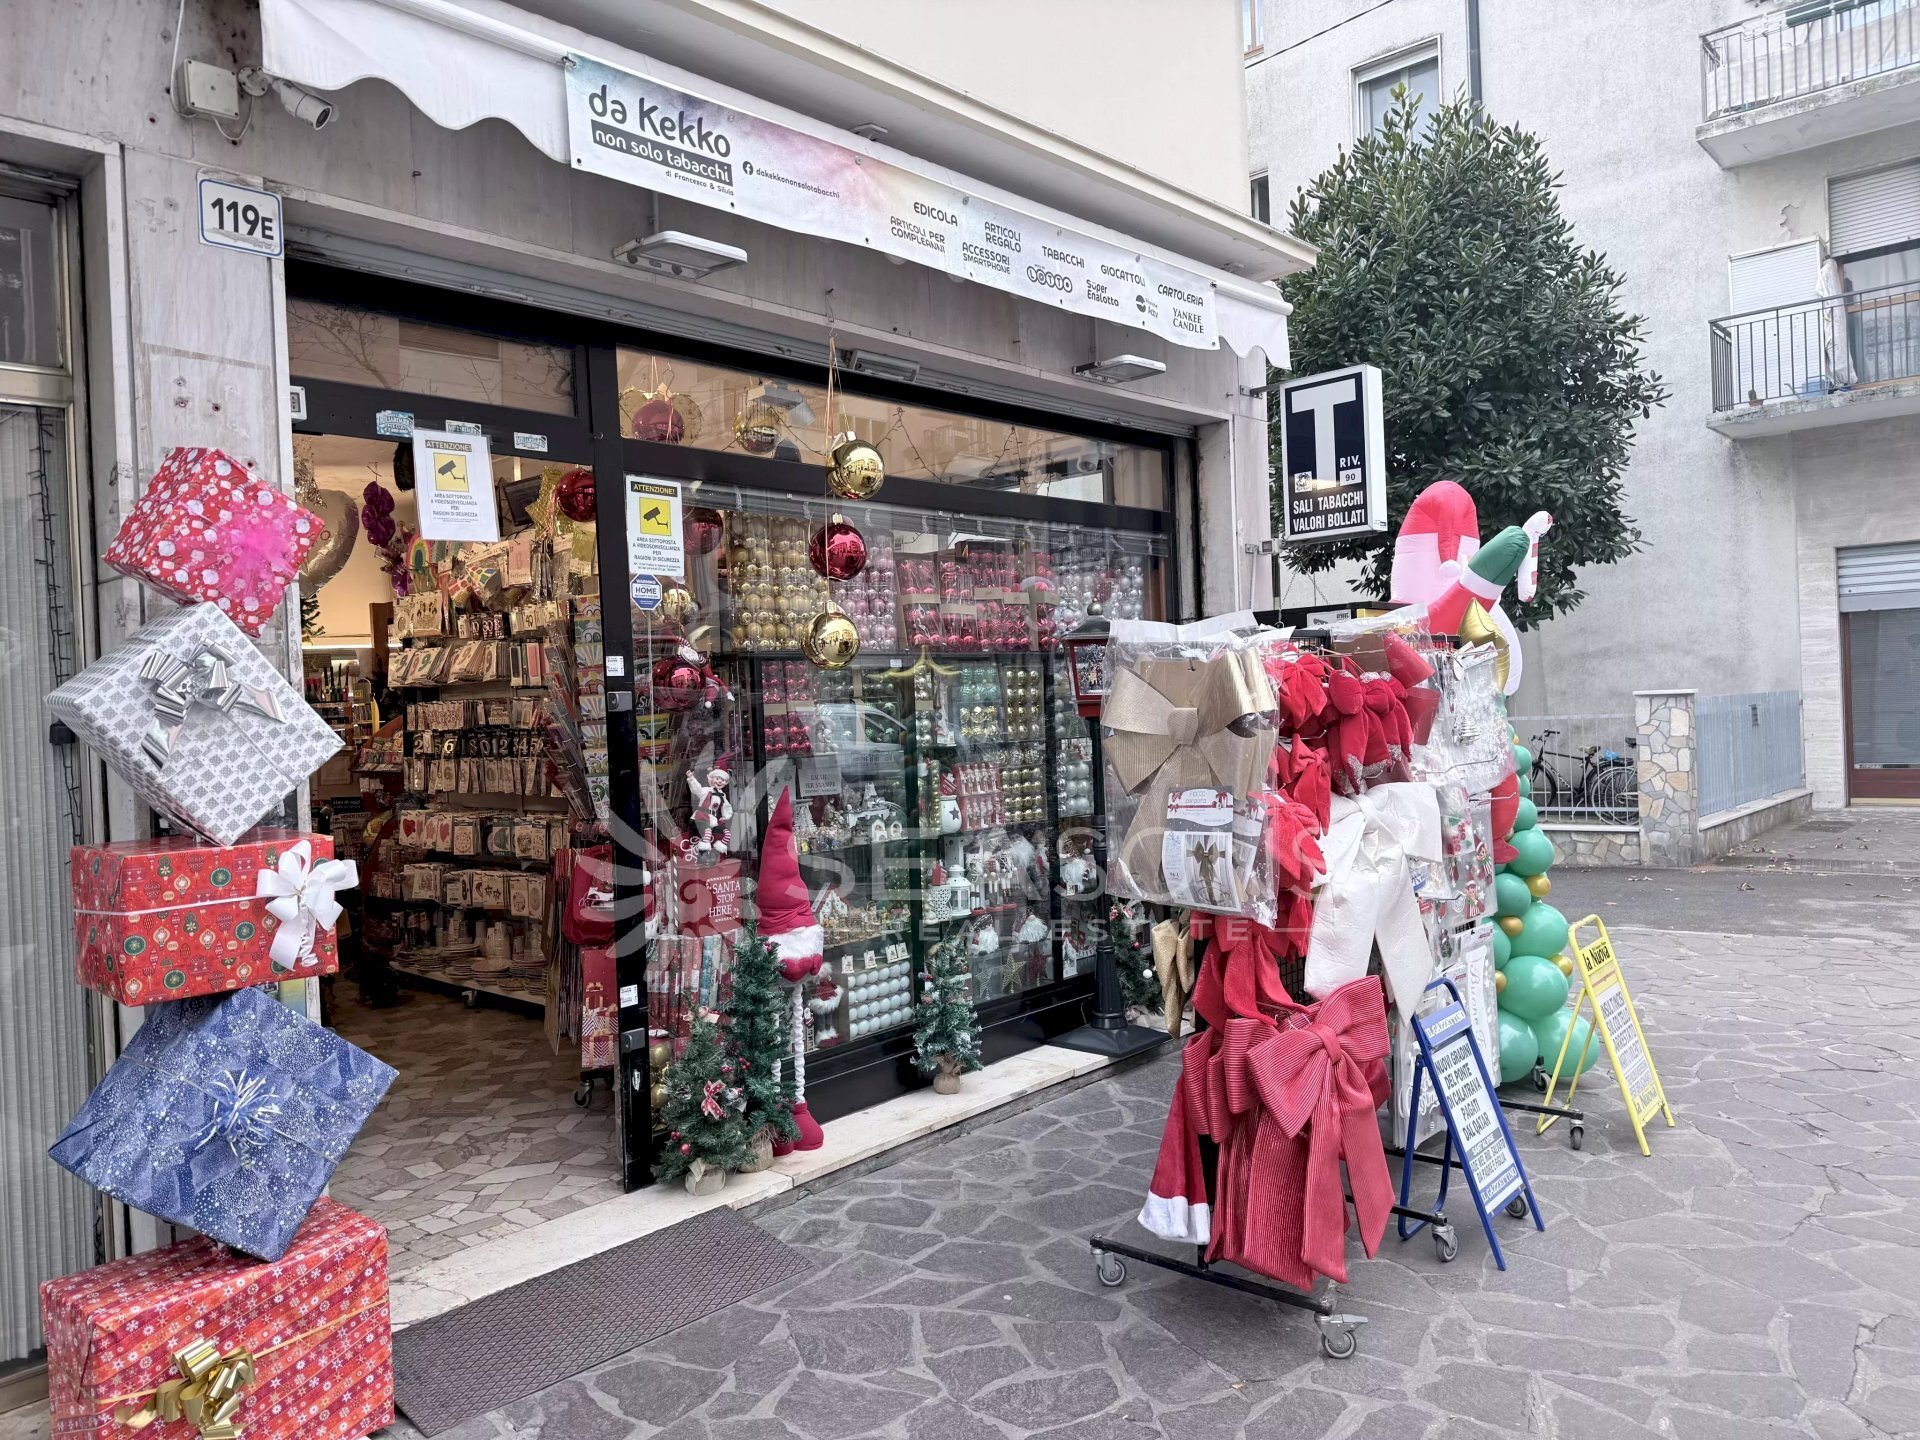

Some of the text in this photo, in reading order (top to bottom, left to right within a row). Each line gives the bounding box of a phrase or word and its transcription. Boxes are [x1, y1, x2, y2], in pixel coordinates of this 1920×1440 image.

[588, 84, 627, 125] da
[595, 130, 730, 183] non solo tabacchi
[665, 170, 734, 196] di Francesco & Silvia
[756, 168, 840, 198] dakekkononsolotabacchi
[913, 201, 958, 227] EDICOLA
[890, 215, 946, 245] ARTICOLI PER
[891, 226, 946, 254] COMPLEANNI
[984, 221, 1021, 243] ARTICOLI
[962, 242, 1010, 266] ACCESSORI
[985, 232, 1022, 253] REGALO
[963, 253, 1011, 275] SMARTPHONE
[1041, 245, 1085, 269] TABACCHI
[1026, 265, 1073, 294] LOTTO
[1100, 264, 1146, 287] GIOCATTOLI
[1087, 289, 1120, 307] Enalotto
[1157, 283, 1204, 307] CARTOLERIA
[1172, 307, 1202, 324] YANKEE
[1172, 318, 1205, 334] CANDLE
[426, 440, 472, 452] ATTENZIONE!
[1290, 377, 1357, 491] T
[1339, 454, 1361, 468] RIV.
[633, 483, 675, 495] ATTENZIONE!
[1345, 473, 1356, 481] 90
[1293, 490, 1364, 515] SALI TABACCHI
[1293, 514, 1325, 533] VALORI
[1327, 508, 1365, 528] BOLLATI
[637, 543, 681, 551] VIDEOSORVEGLIANZA
[635, 586, 657, 595] HOME
[712, 880, 741, 895] SANTA
[716, 893, 736, 905] STOP
[708, 904, 732, 918] HERE
[1582, 952, 1592, 971] la
[1589, 945, 1610, 967] Nuova
[1434, 1054, 1452, 1075] NUOVI
[1449, 1042, 1471, 1065] GRADINI
[1444, 1062, 1472, 1089] DEL PONTE
[1447, 1093, 1456, 1109] DI
[1452, 1076, 1481, 1105] CALATRAVA
[1460, 1098, 1480, 1121] PAGATI
[1462, 1111, 1491, 1141] DAL QATAR
